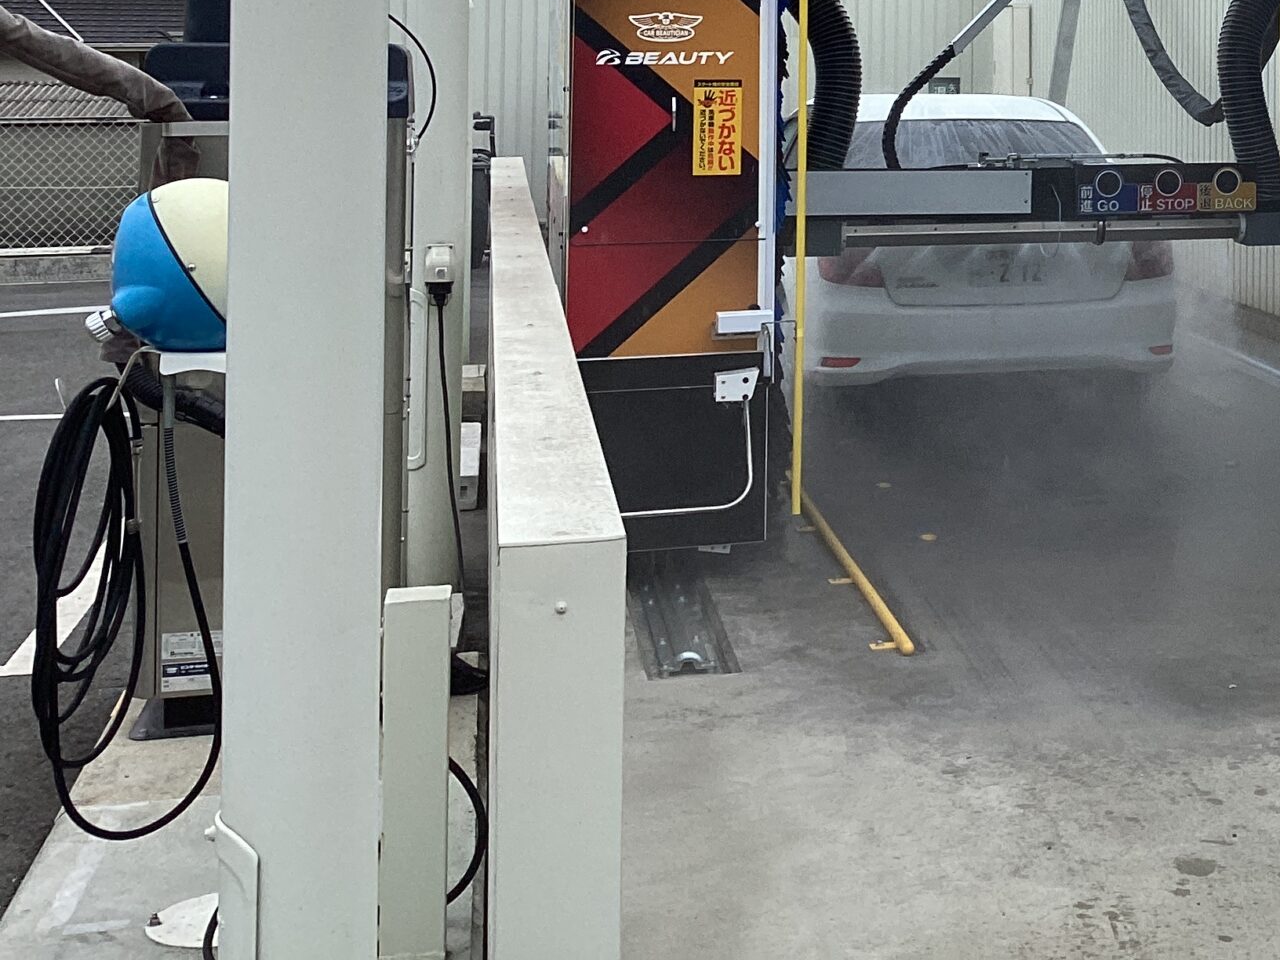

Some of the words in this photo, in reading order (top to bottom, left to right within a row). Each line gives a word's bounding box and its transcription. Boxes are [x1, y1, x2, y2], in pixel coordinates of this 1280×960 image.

[625, 52, 735, 65] BEAUTY
[718, 89, 736, 171] 近づかない
[1080, 186, 1093, 212] 前進
[1097, 200, 1119, 211] GO
[1140, 185, 1153, 211] 停止
[1155, 199, 1194, 210] STOP
[1214, 198, 1253, 209] BACK
